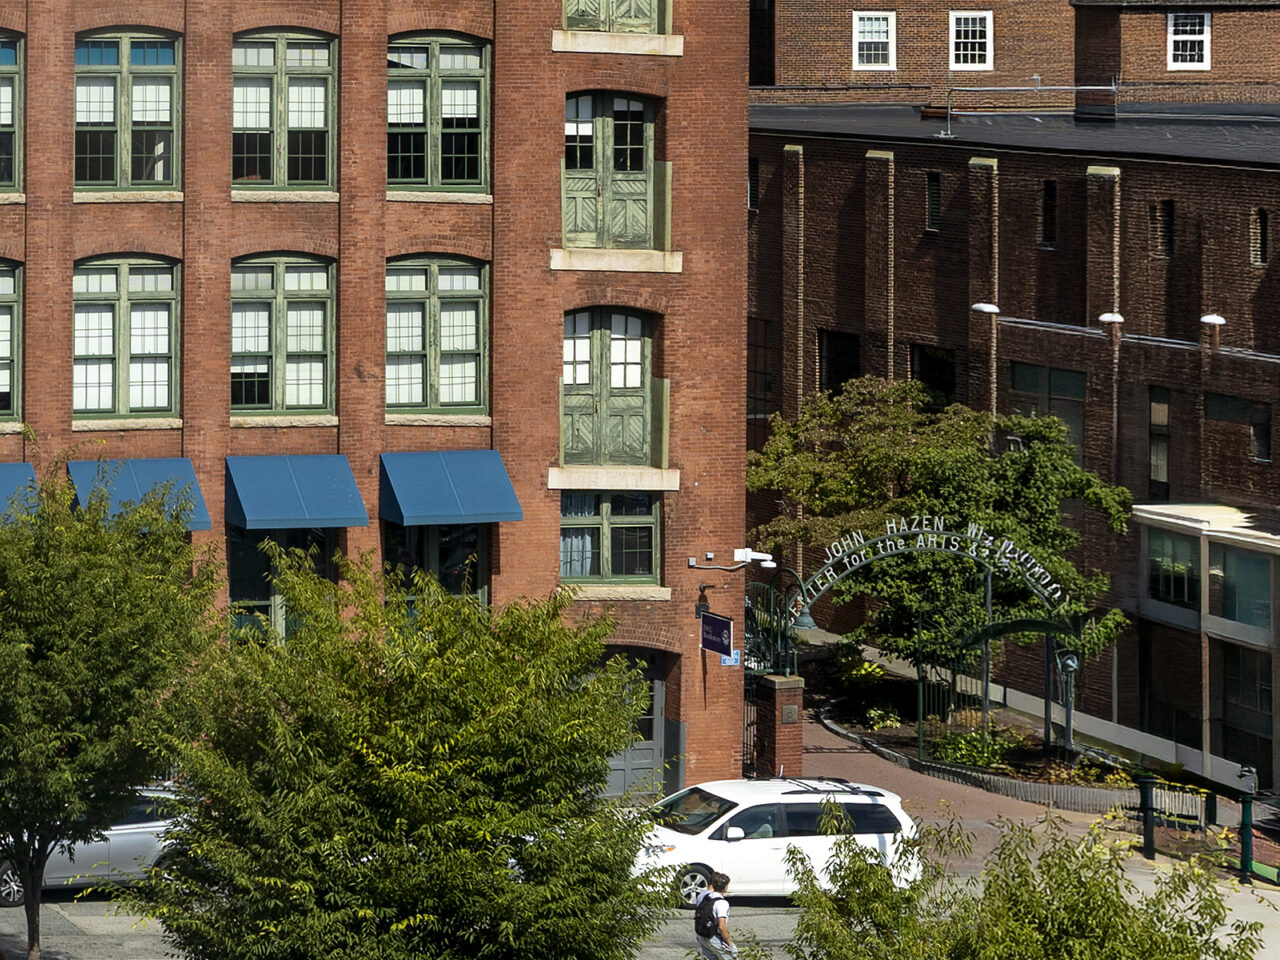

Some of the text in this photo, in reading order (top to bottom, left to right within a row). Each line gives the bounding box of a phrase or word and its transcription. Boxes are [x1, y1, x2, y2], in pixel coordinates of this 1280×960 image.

[823, 515, 944, 565] JOHN HAZEN
[842, 549, 867, 571] for
[877, 537, 906, 555] the
[916, 535, 959, 551] ARTS
